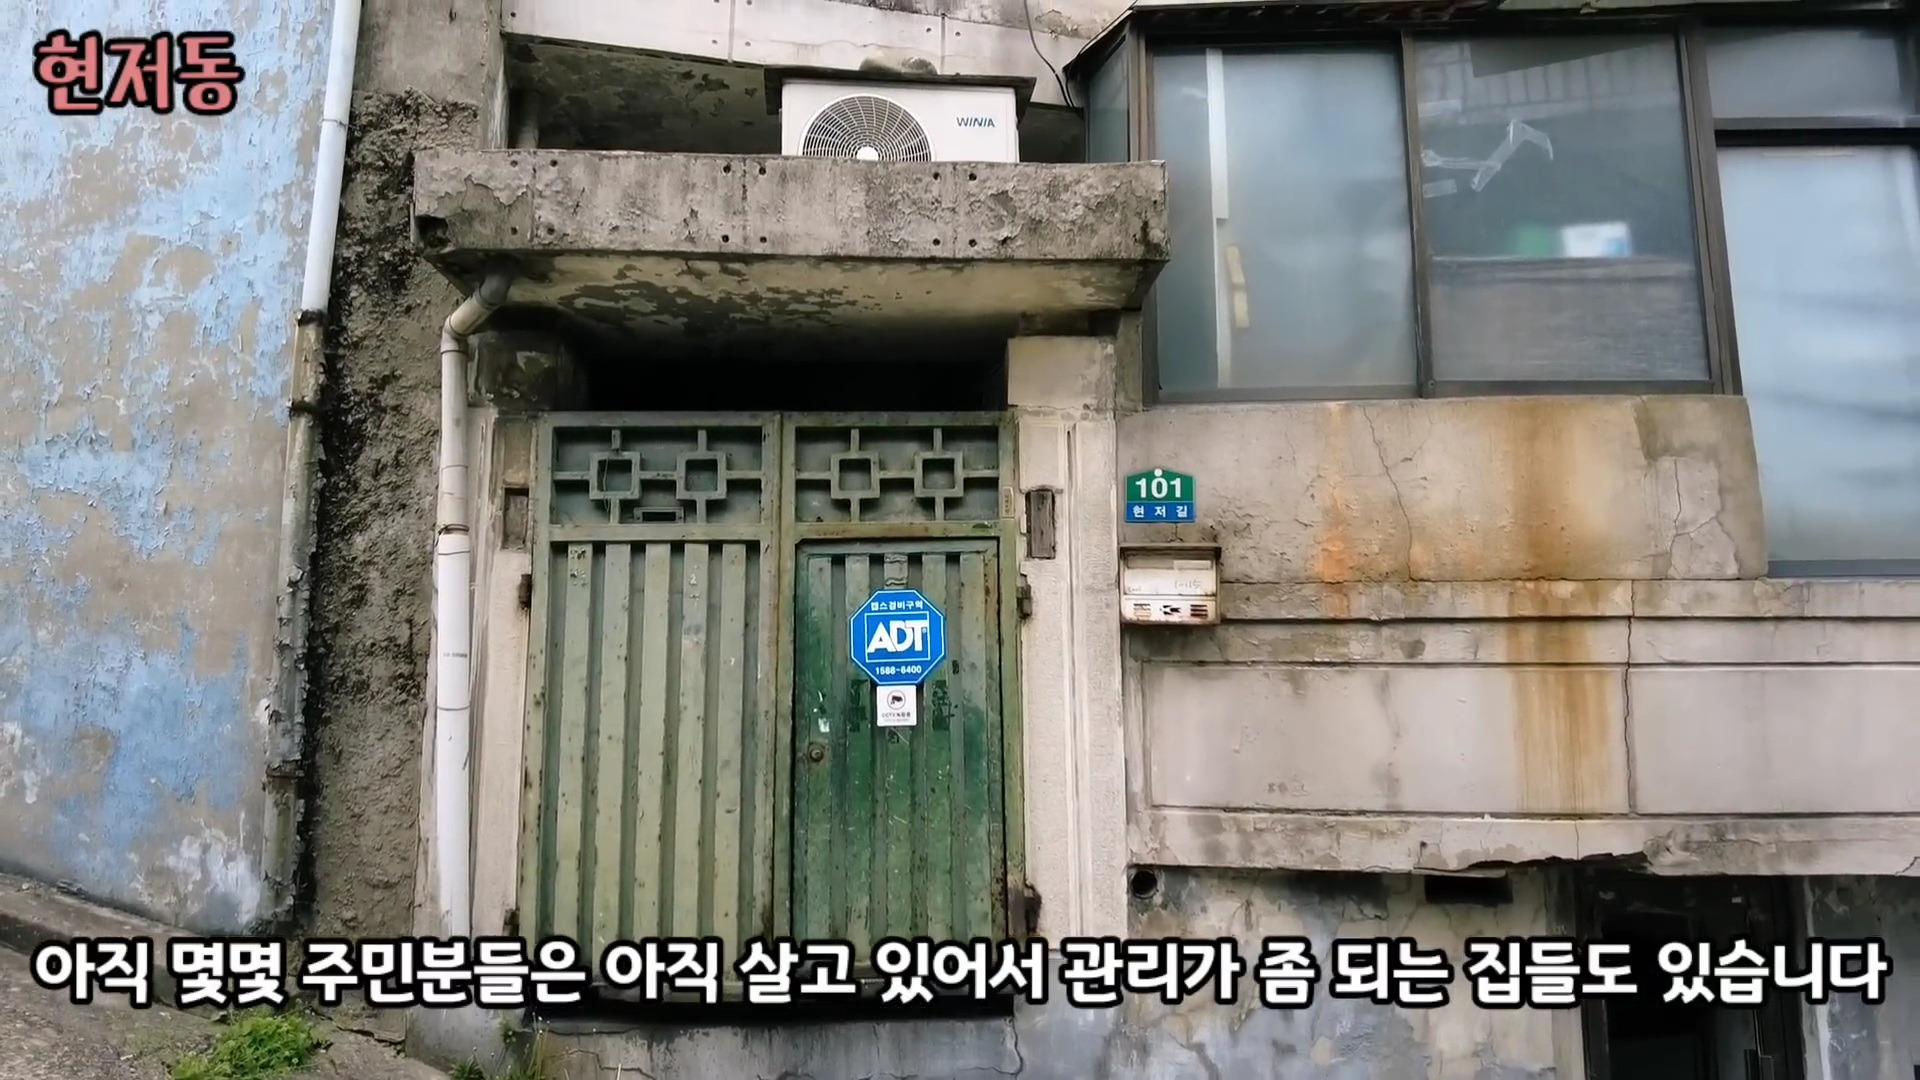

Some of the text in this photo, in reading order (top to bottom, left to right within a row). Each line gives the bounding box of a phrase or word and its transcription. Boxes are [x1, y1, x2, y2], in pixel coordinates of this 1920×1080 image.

[956, 116, 996, 128] WINIA
[1135, 476, 1183, 499] 101
[867, 619, 928, 653] ADT
[875, 665, 922, 675] 1588-6400
